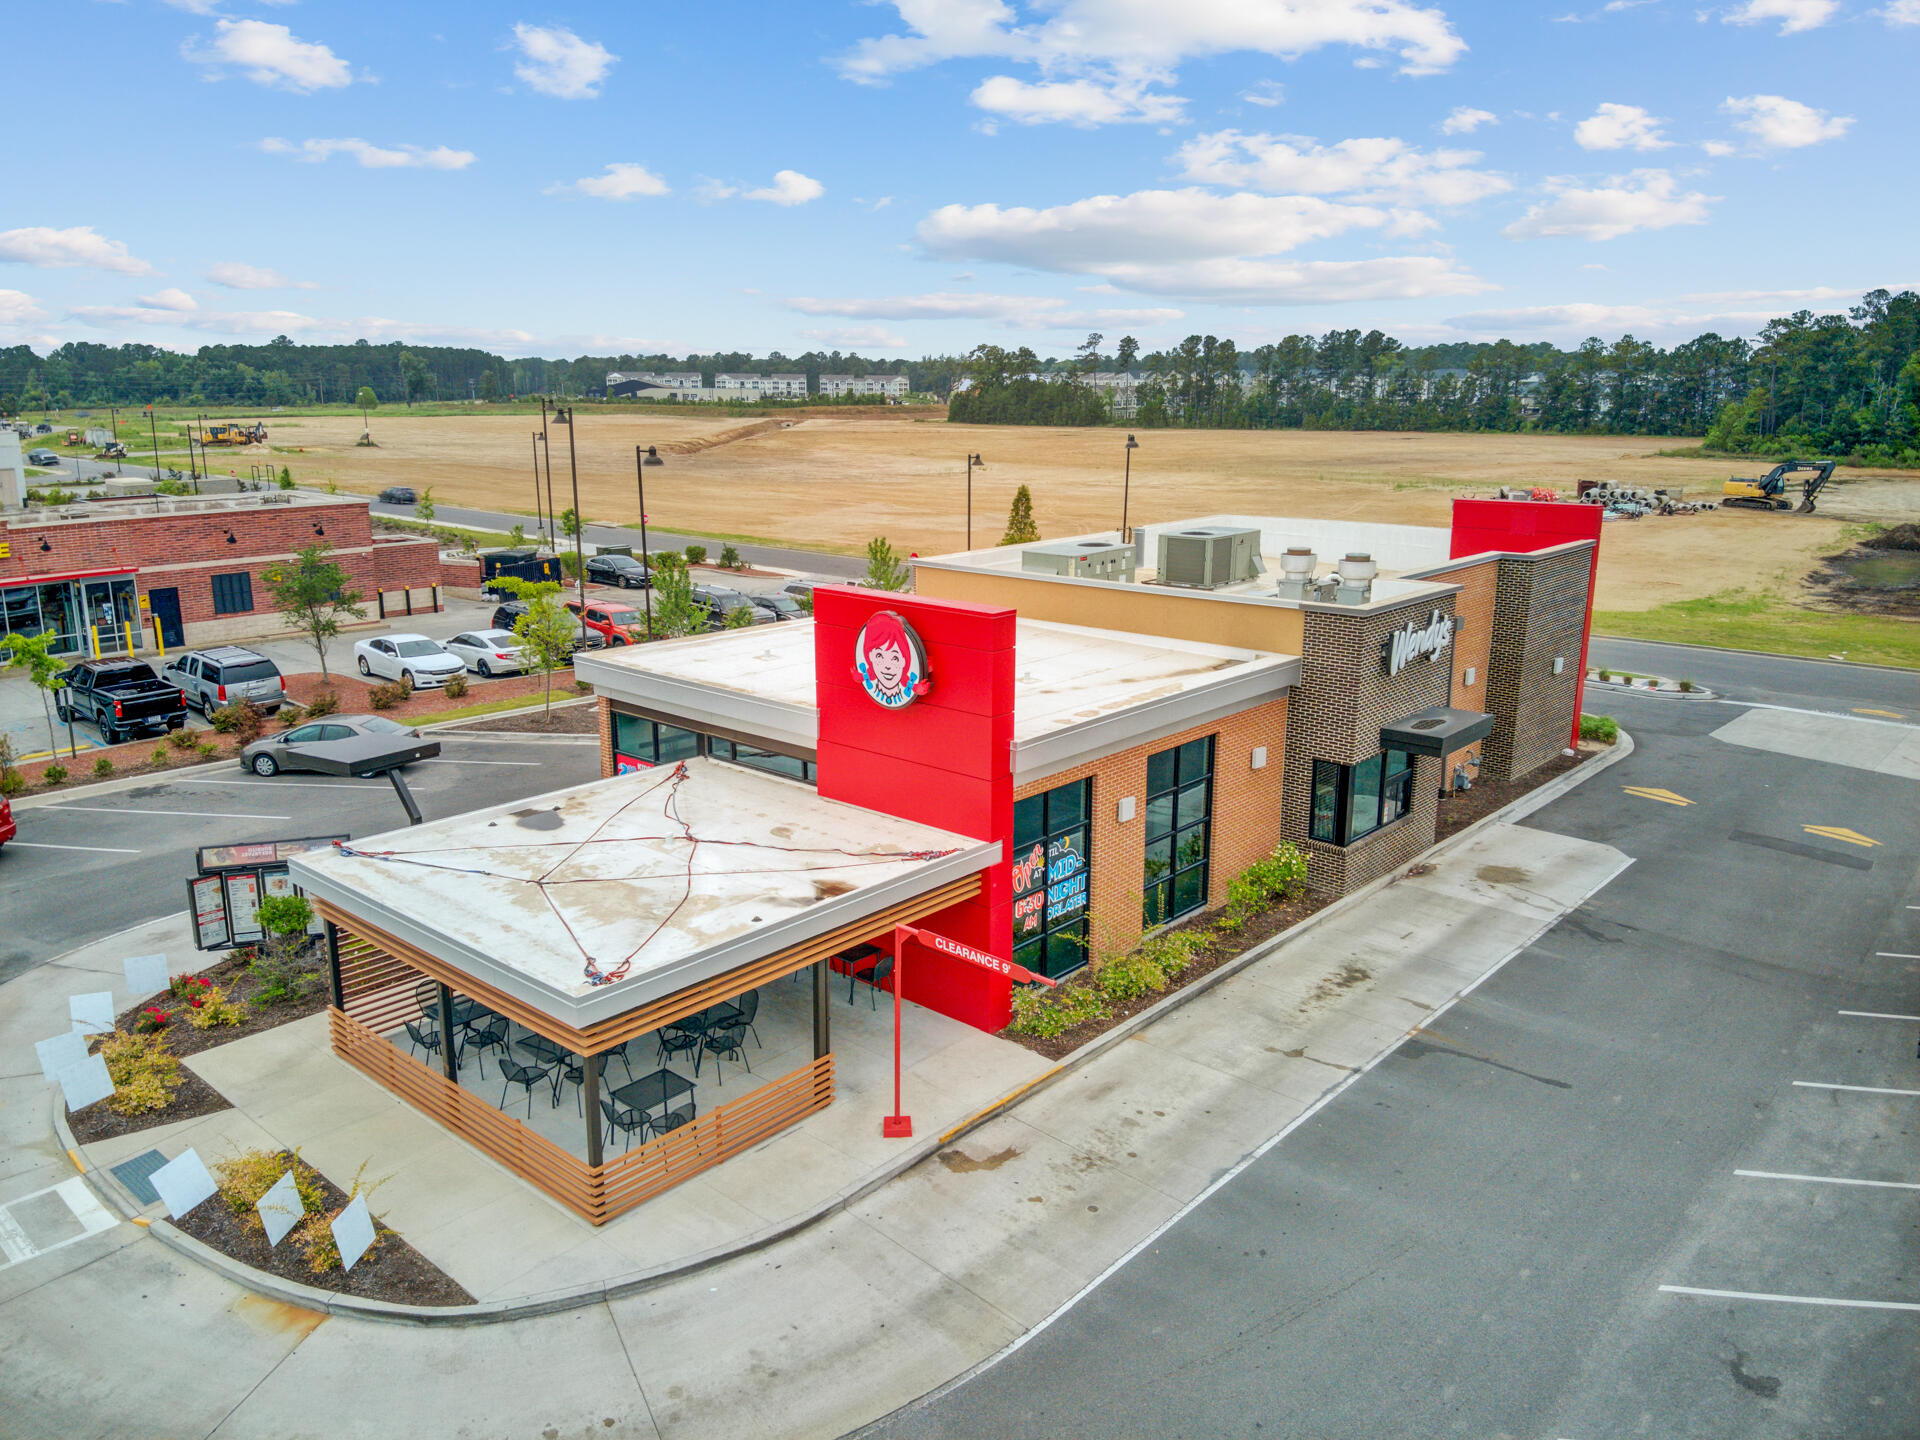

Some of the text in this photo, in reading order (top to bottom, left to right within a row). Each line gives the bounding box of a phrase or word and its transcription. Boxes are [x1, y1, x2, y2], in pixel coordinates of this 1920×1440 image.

[1390, 609, 1452, 676] Wendy's
[1012, 844, 1044, 893] Open
[1033, 868, 1042, 879] AT
[1047, 872, 1087, 906] NIGHT
[1023, 912, 1038, 932] AM
[935, 937, 1000, 971] CLEARANCE
